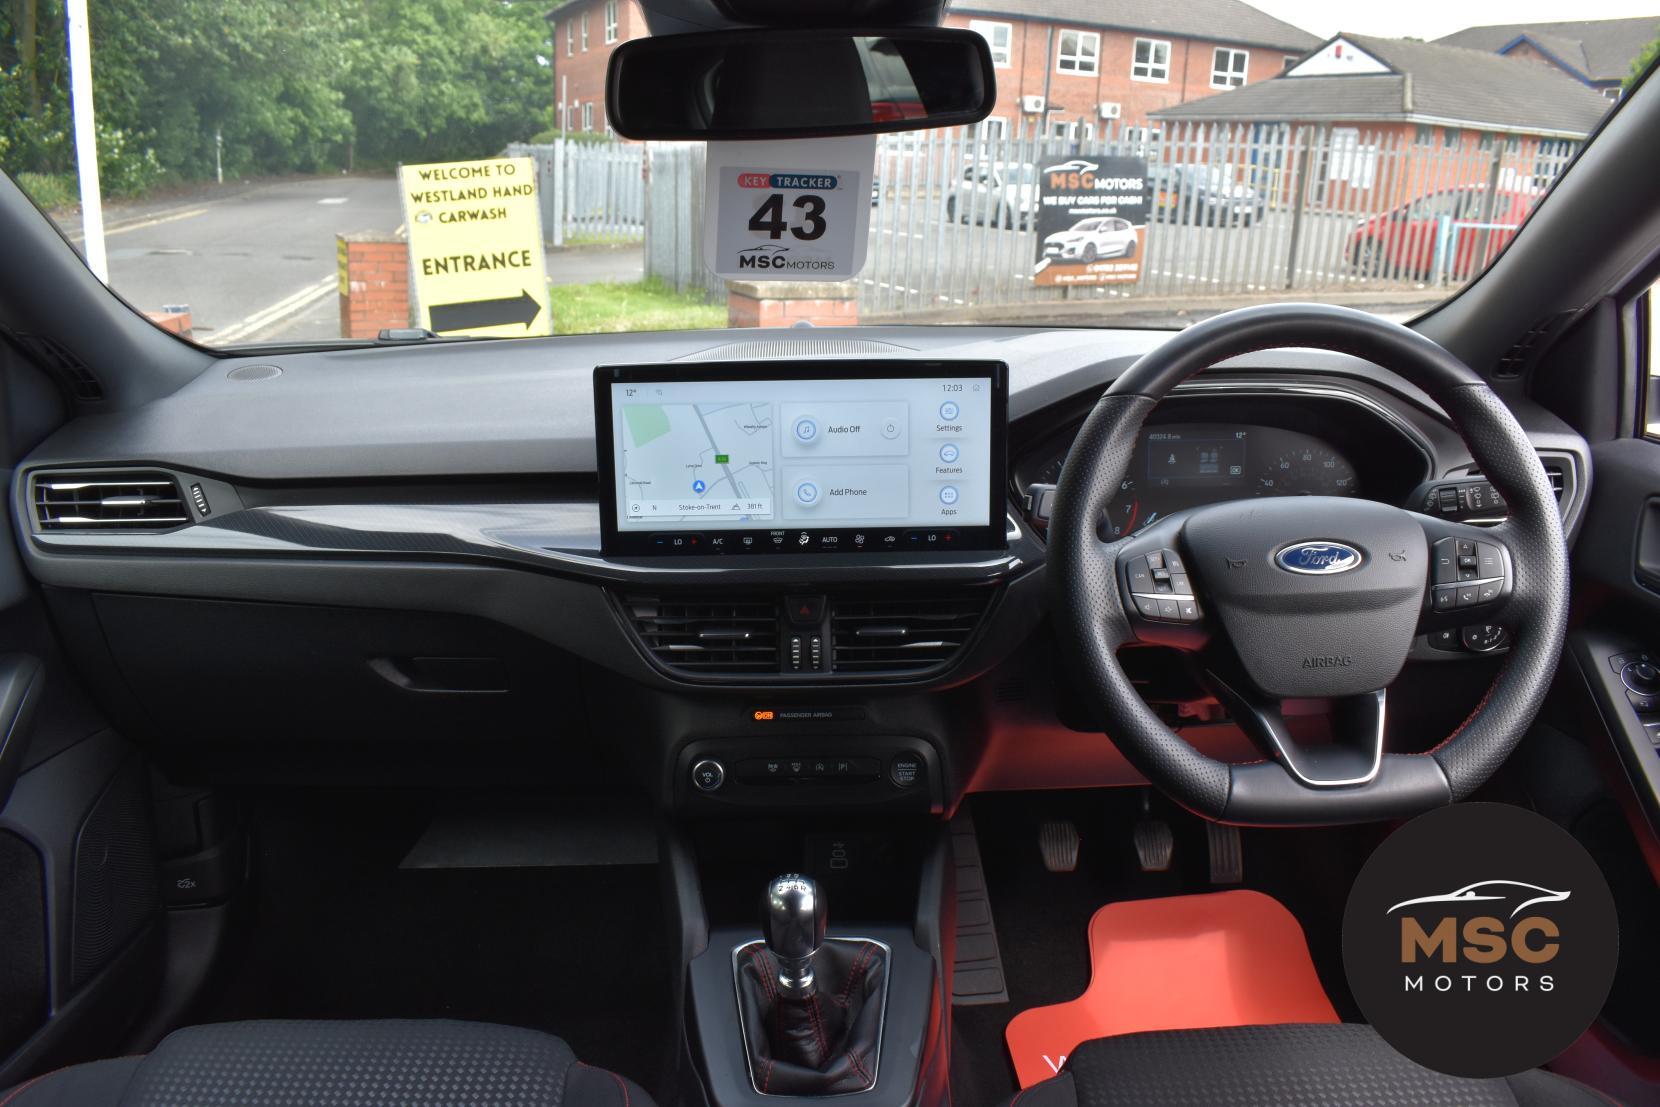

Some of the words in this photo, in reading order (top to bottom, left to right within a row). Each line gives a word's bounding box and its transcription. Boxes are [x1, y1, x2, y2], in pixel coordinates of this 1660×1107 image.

[419, 165, 491, 181] WELCOME
[495, 164, 516, 176] TO
[744, 175, 767, 186] KEY
[776, 176, 832, 188] TRACKER
[1050, 172, 1094, 190] MSC
[1094, 178, 1144, 190] MOTORS
[411, 187, 488, 204] WESTLAND
[493, 184, 533, 198] HAND
[438, 207, 507, 224] CARWASH
[748, 193, 827, 241] 43
[422, 250, 532, 276] ENTRANCE
[739, 255, 786, 269] MSC
[942, 384, 963, 392] 12:03
[828, 425, 848, 433] Audio
[849, 425, 861, 433] Off
[936, 424, 963, 432] Settings
[935, 466, 963, 474] Features
[1121, 481, 1128, 490] 6
[829, 488, 843, 496] Add
[844, 488, 867, 496] Phone
[678, 503, 721, 511] Stoke-on-Trent
[941, 508, 957, 516] Apps
[1125, 504, 1132, 514] 7
[1114, 526, 1120, 535] 8
[1299, 547, 1340, 565] Ford
[1301, 655, 1352, 669] AIRBAG
